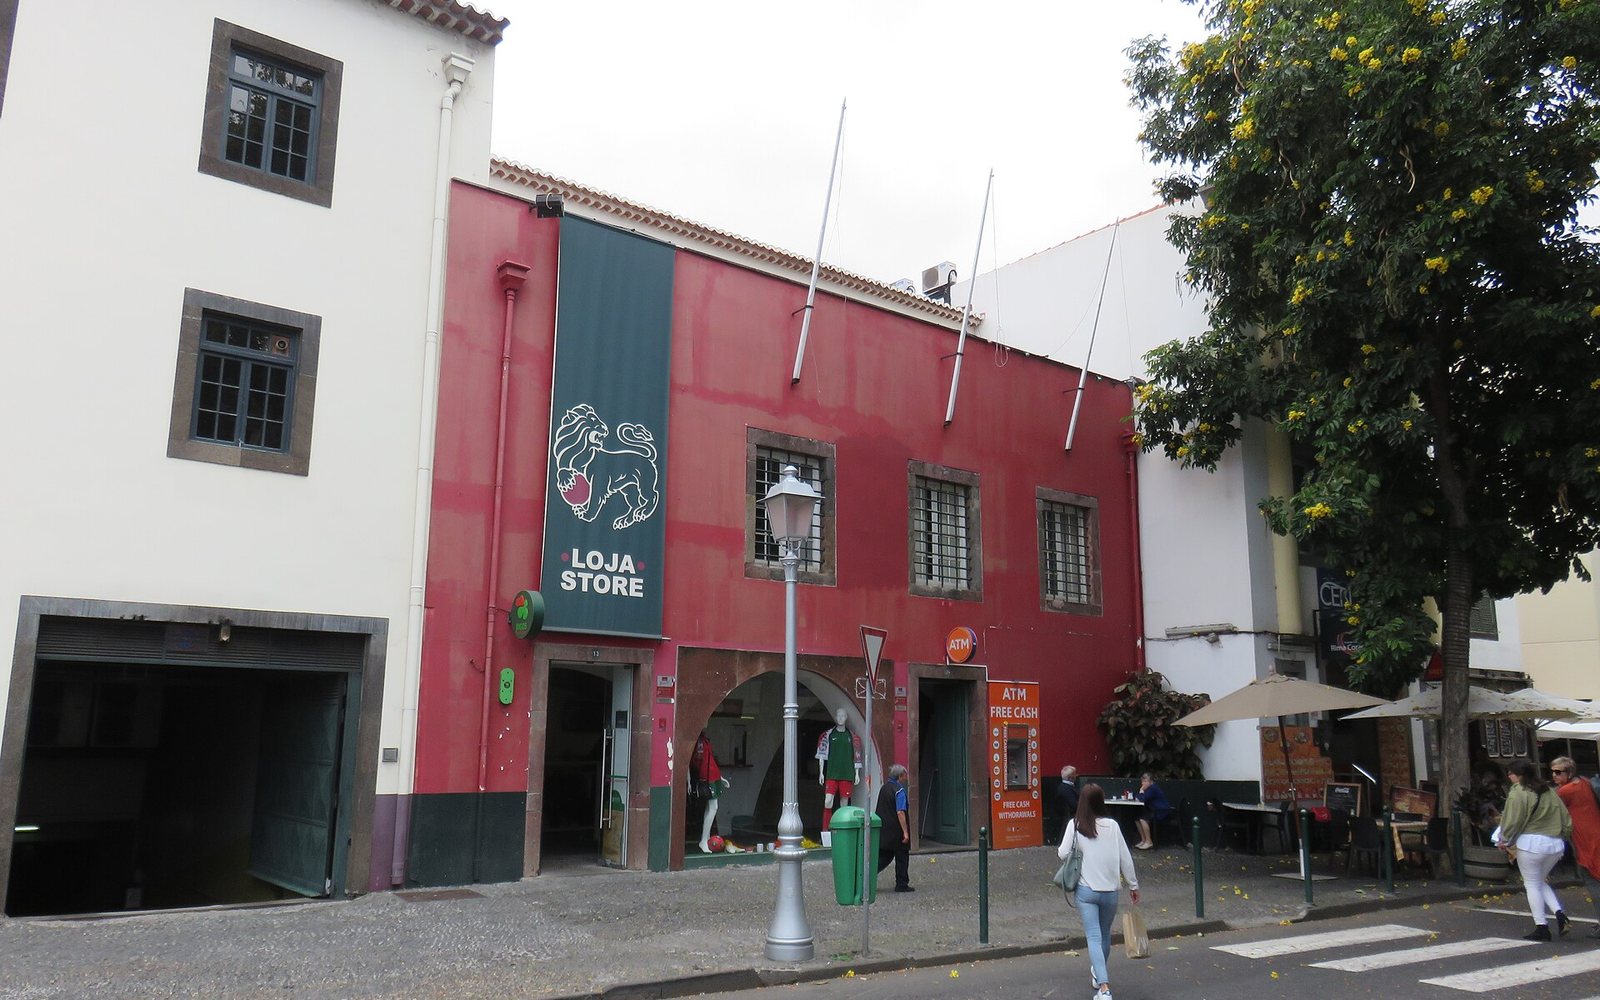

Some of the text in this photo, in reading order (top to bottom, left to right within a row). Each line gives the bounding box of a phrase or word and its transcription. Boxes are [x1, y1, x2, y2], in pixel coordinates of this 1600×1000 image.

[571, 548, 636, 574] LOJA
[560, 571, 644, 597] STORE
[949, 638, 970, 650] ATM
[1002, 687, 1027, 701] ATM
[990, 706, 1038, 719] FREE CASH
[1002, 800, 1031, 809] FREE CASH
[998, 810, 1036, 820] WITHDRAWALS
